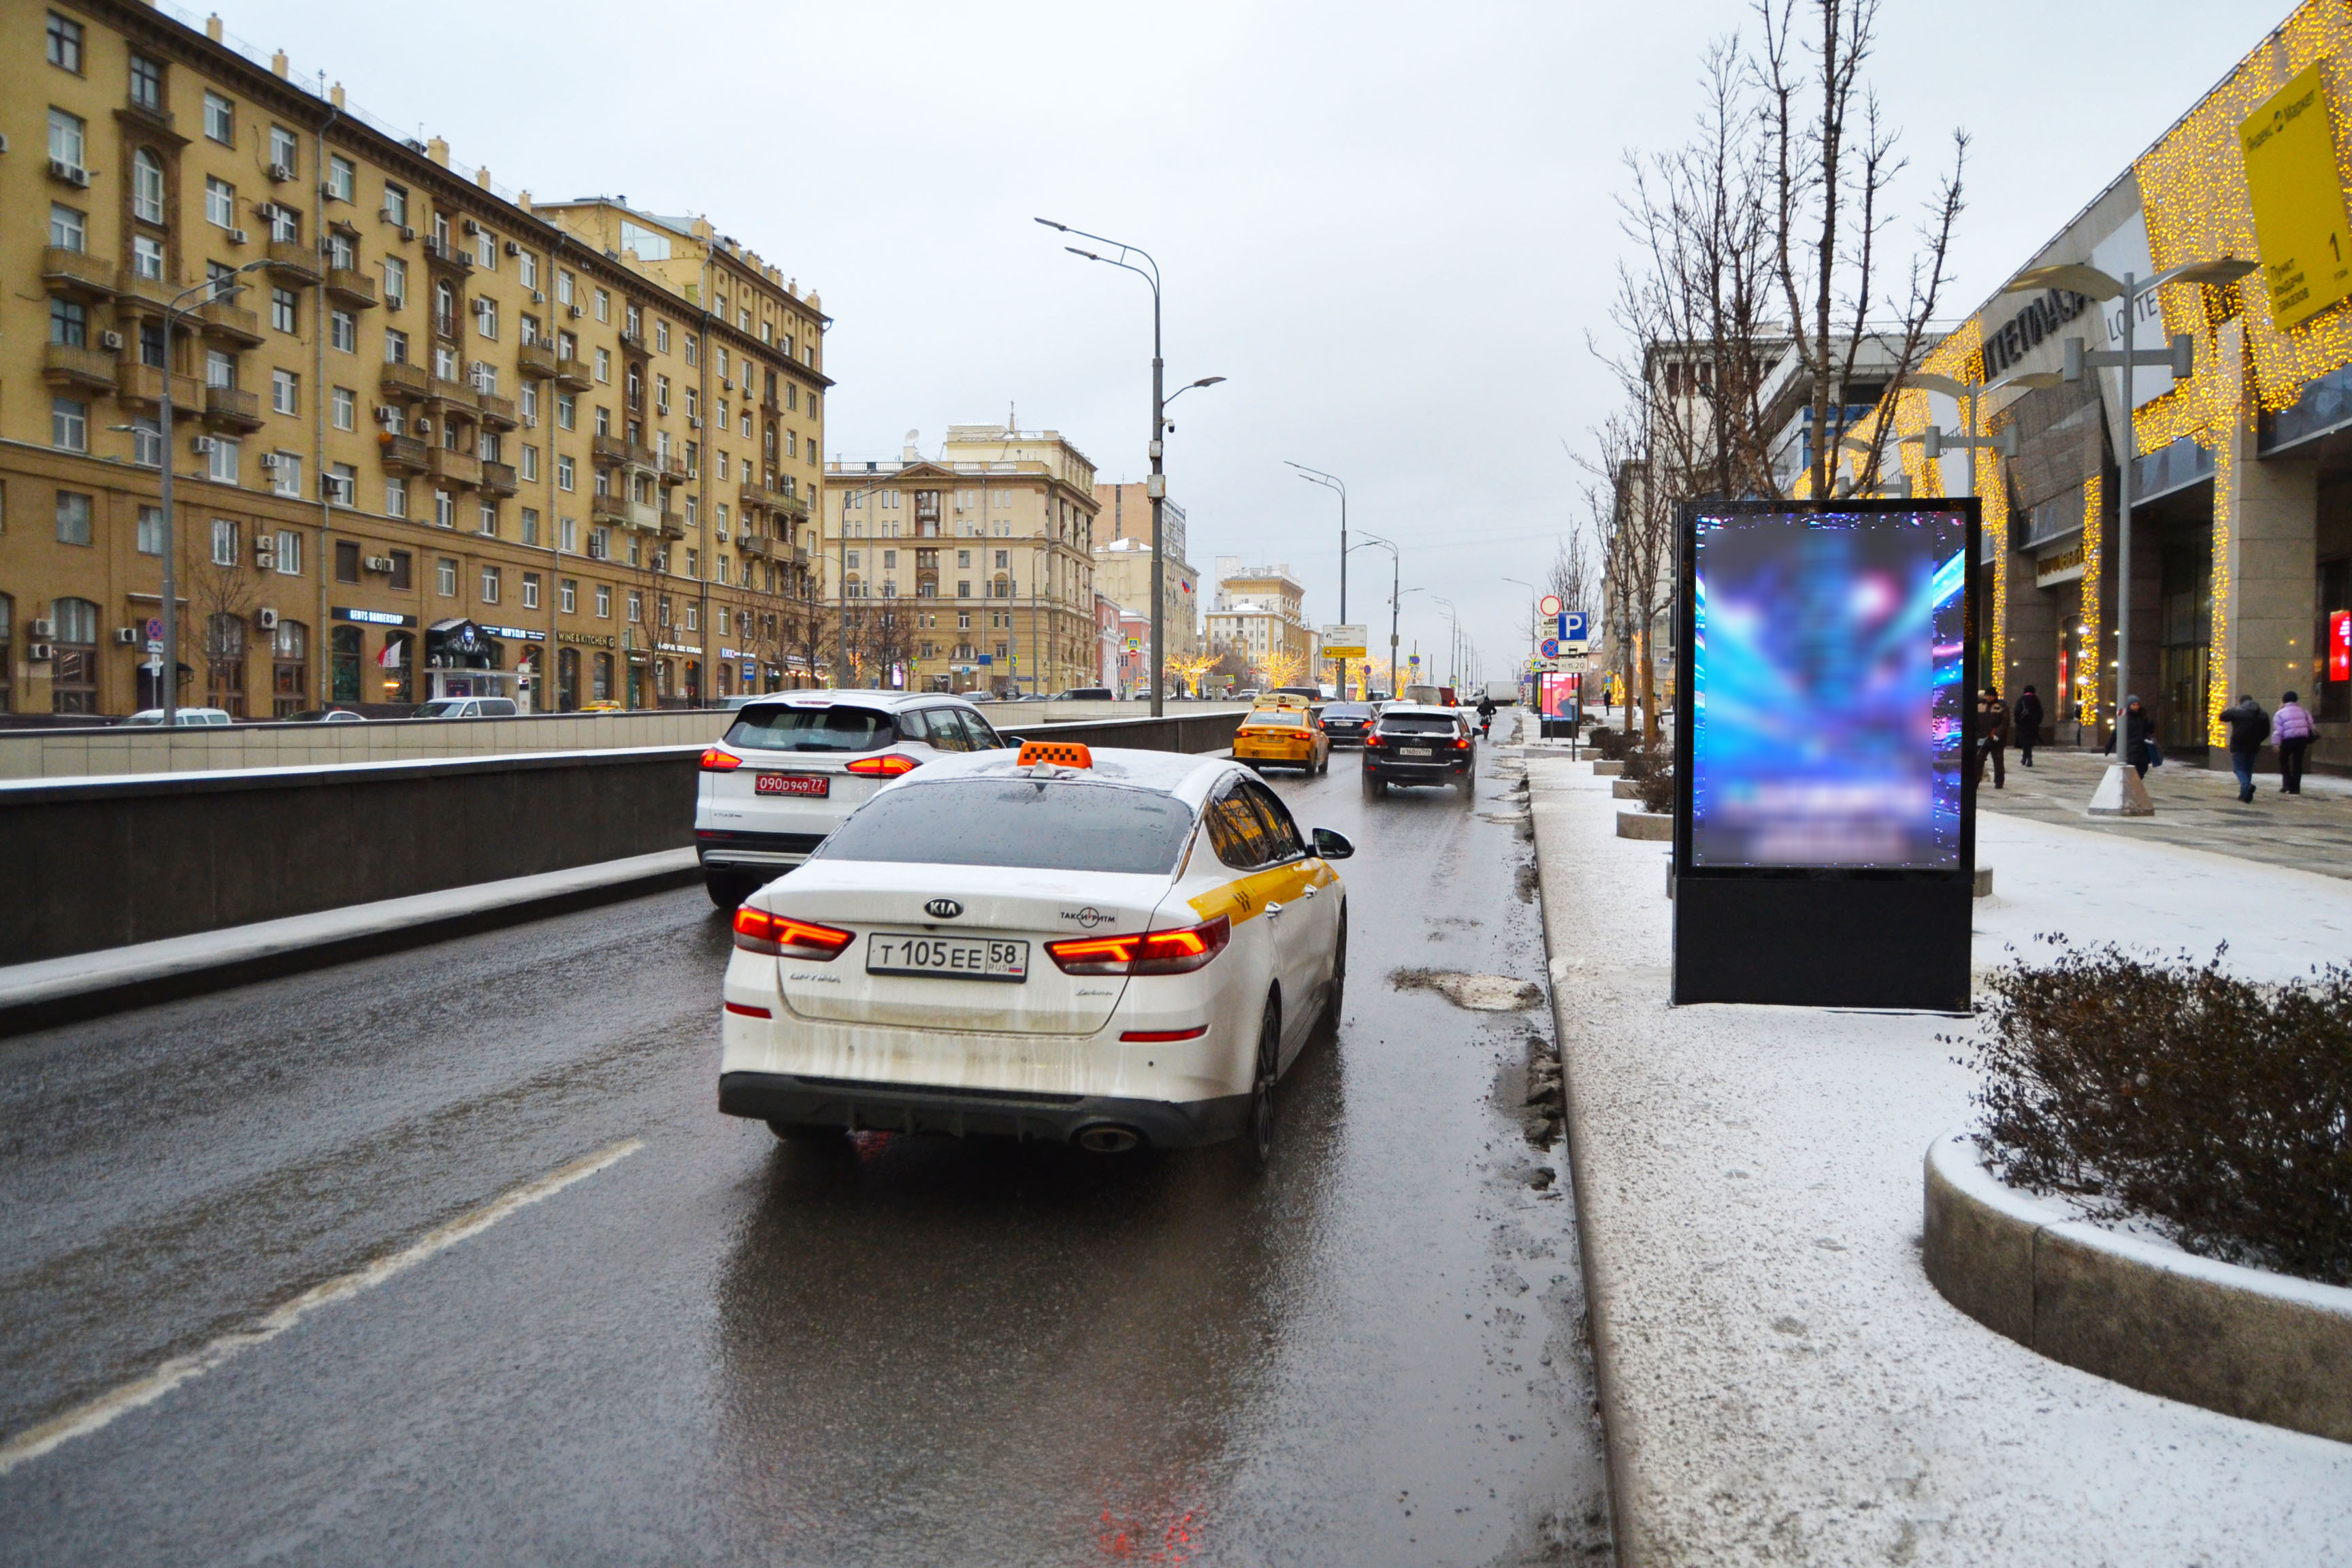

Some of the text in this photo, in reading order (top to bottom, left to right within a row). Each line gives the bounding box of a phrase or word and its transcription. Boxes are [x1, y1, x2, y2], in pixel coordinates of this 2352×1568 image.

[2330, 232, 2341, 262] 1
[2270, 258, 2294, 282] Пункт
[2107, 291, 2158, 342] LOTE
[1566, 615, 1582, 638] P
[558, 632, 574, 642] WINE
[575, 634, 580, 642] &
[581, 634, 607, 646] KITCHEN
[608, 638, 615, 647] G
[811, 779, 823, 788] 77
[930, 902, 957, 915] KIA
[1061, 912, 1115, 924] ТАКСИ РИТМ
[990, 943, 1016, 964] 58
[988, 963, 1008, 972] RUS
